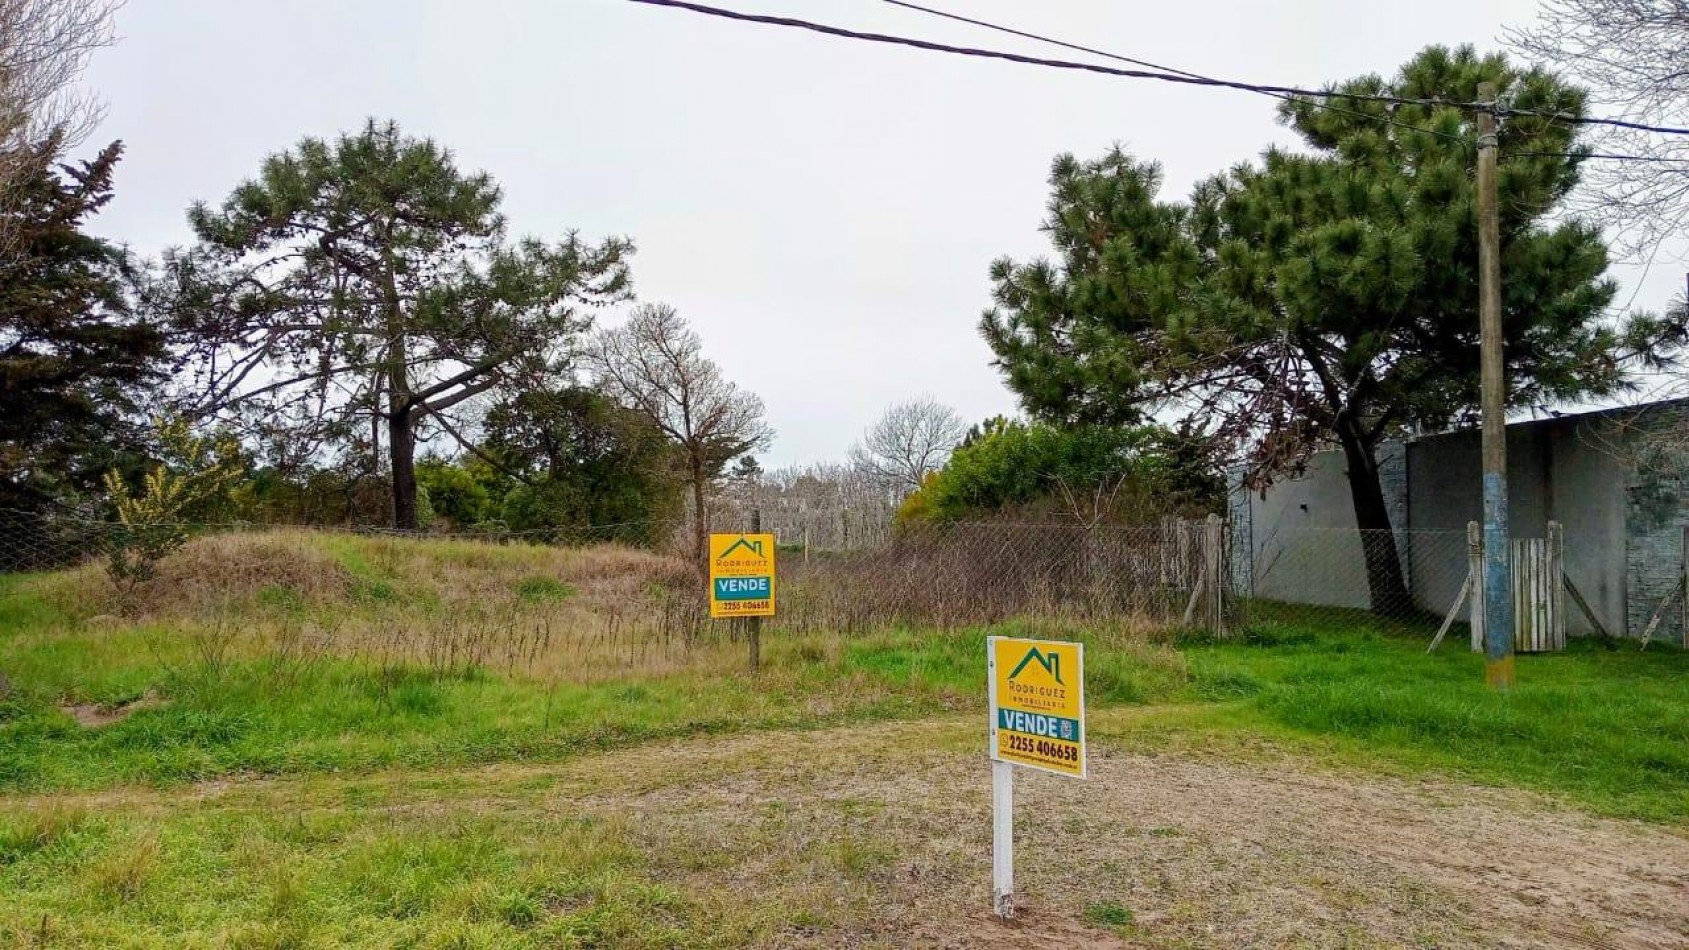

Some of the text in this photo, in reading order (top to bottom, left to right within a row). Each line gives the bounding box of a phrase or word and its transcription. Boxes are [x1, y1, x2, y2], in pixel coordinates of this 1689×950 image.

[716, 559, 768, 567] RODRIGUEZ
[718, 579, 768, 592] VENDE
[723, 602, 741, 610] 2255
[1009, 680, 1066, 699] RODRIGUEZ
[1004, 710, 1058, 738] VENDE
[1009, 734, 1034, 753] 2255
[1036, 740, 1078, 762] 406658
